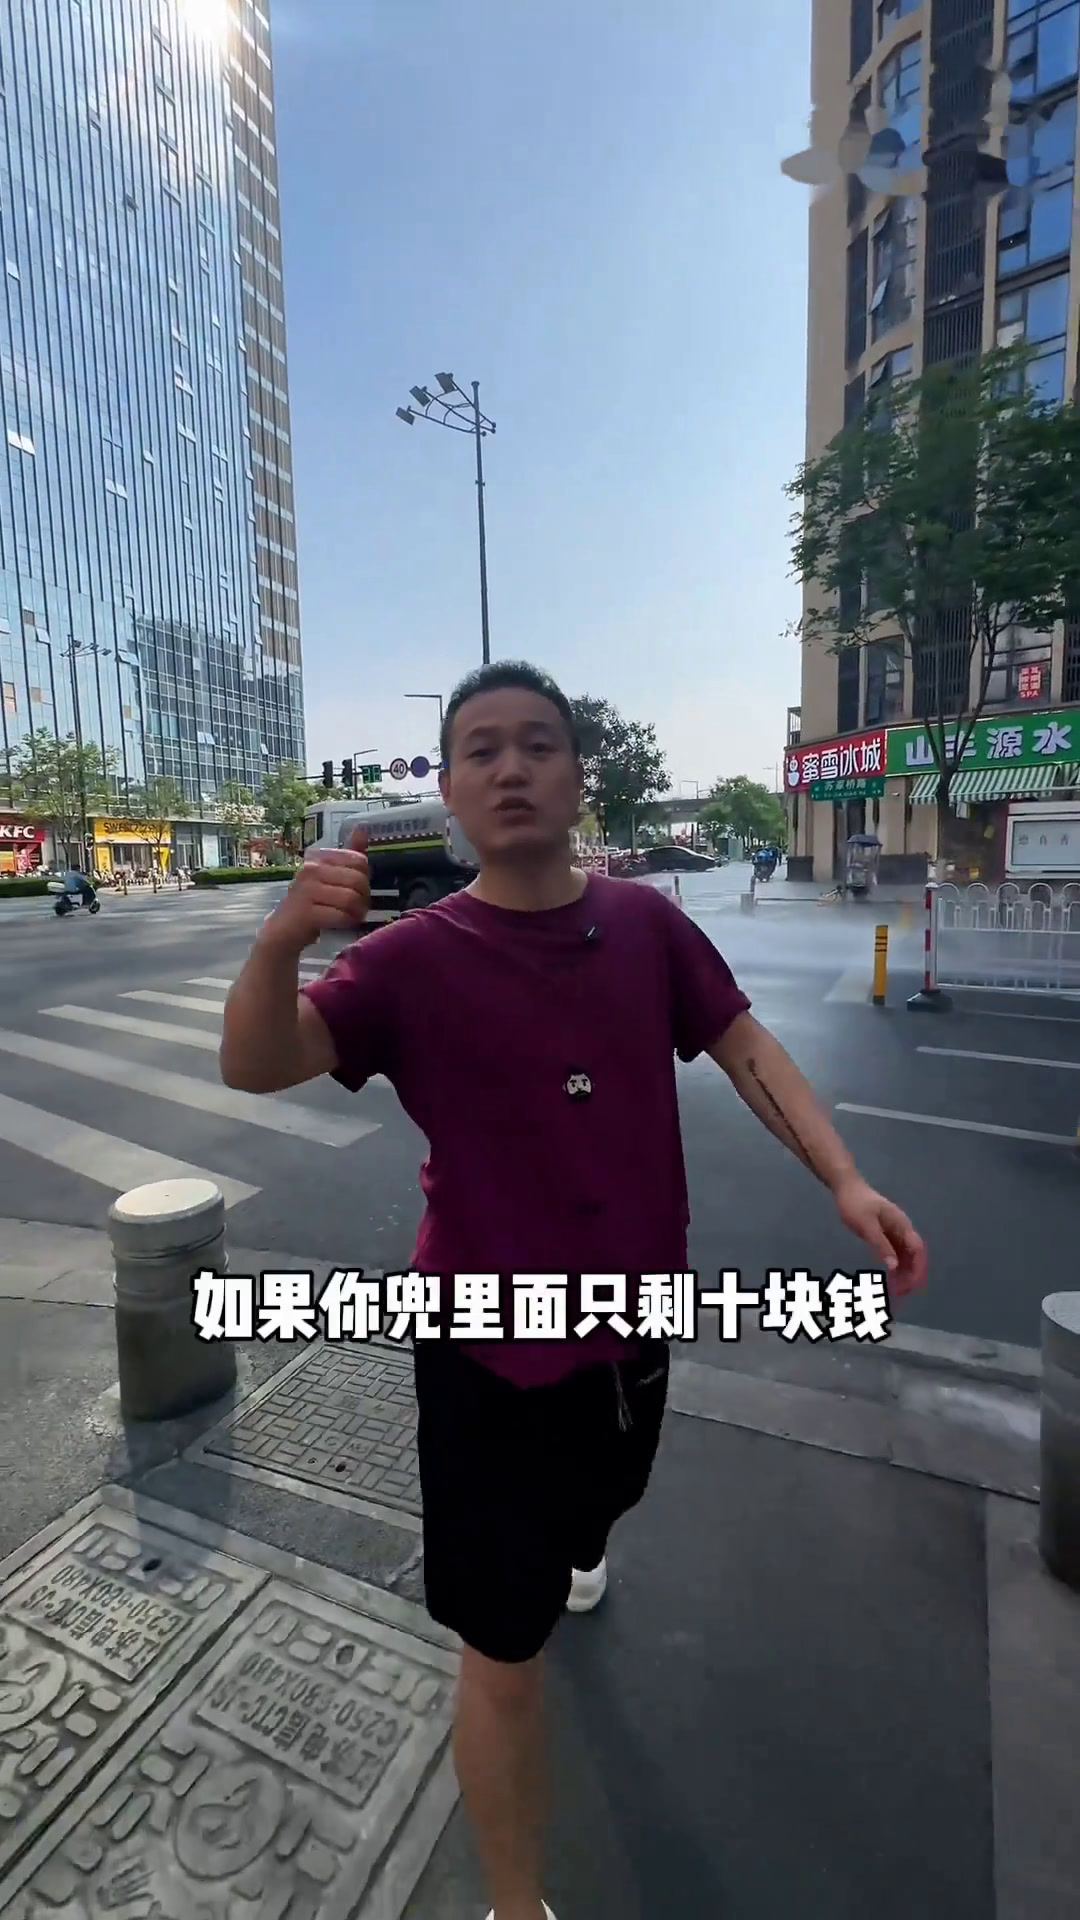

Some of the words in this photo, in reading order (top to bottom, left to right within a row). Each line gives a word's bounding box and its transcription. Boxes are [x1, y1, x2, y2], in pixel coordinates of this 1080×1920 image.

[1020, 690, 1039, 698] SPA
[801, 737, 881, 784] 蜜雪冰城
[393, 764, 405, 775] 40
[0, 825, 35, 840] KFC
